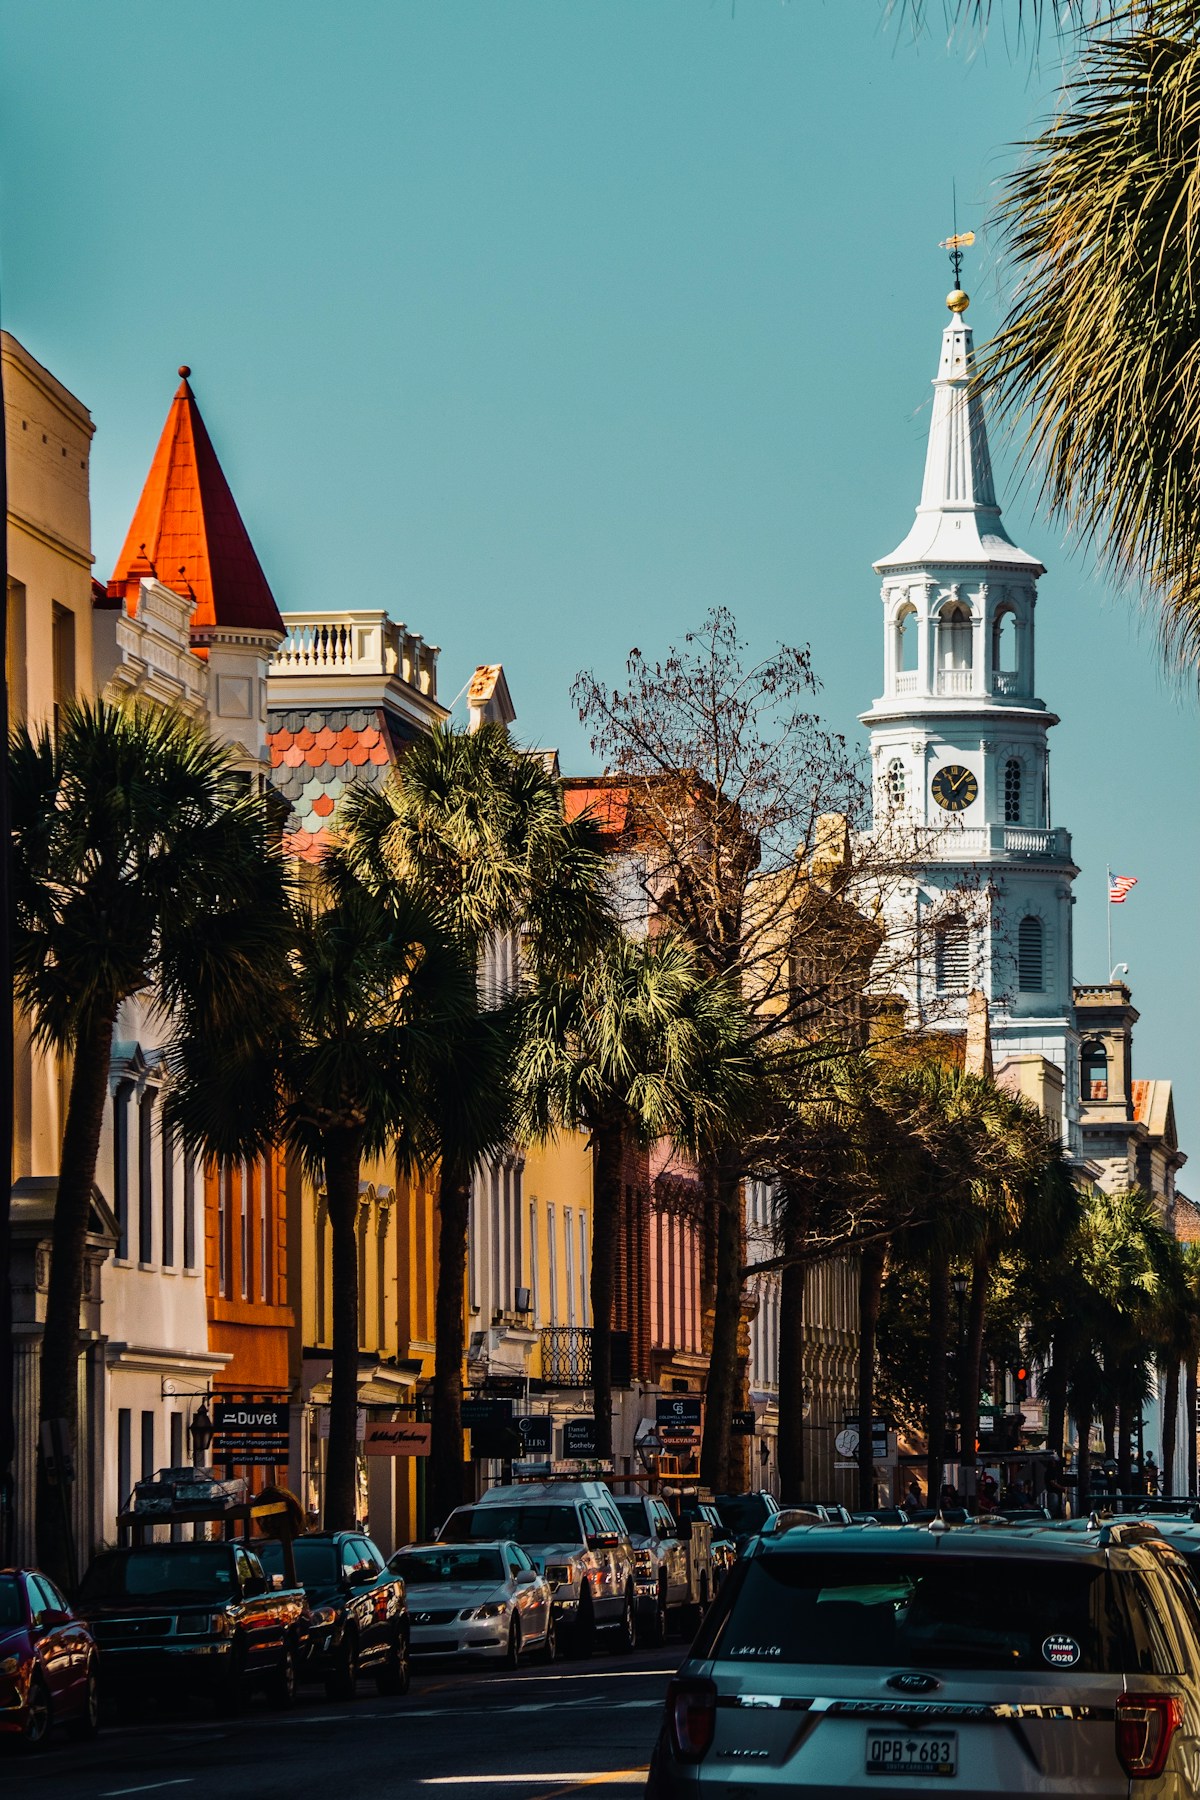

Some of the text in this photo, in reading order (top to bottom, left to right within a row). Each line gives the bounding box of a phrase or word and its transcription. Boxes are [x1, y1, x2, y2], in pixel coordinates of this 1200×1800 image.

[237, 1411, 278, 1425] Duvet
[729, 1645, 781, 1655] Lake Life
[1047, 1643, 1074, 1651] TRUMP
[1050, 1653, 1074, 1662] 2020
[899, 1675, 928, 1687] Ford
[871, 1740, 950, 1762] QPB 683
